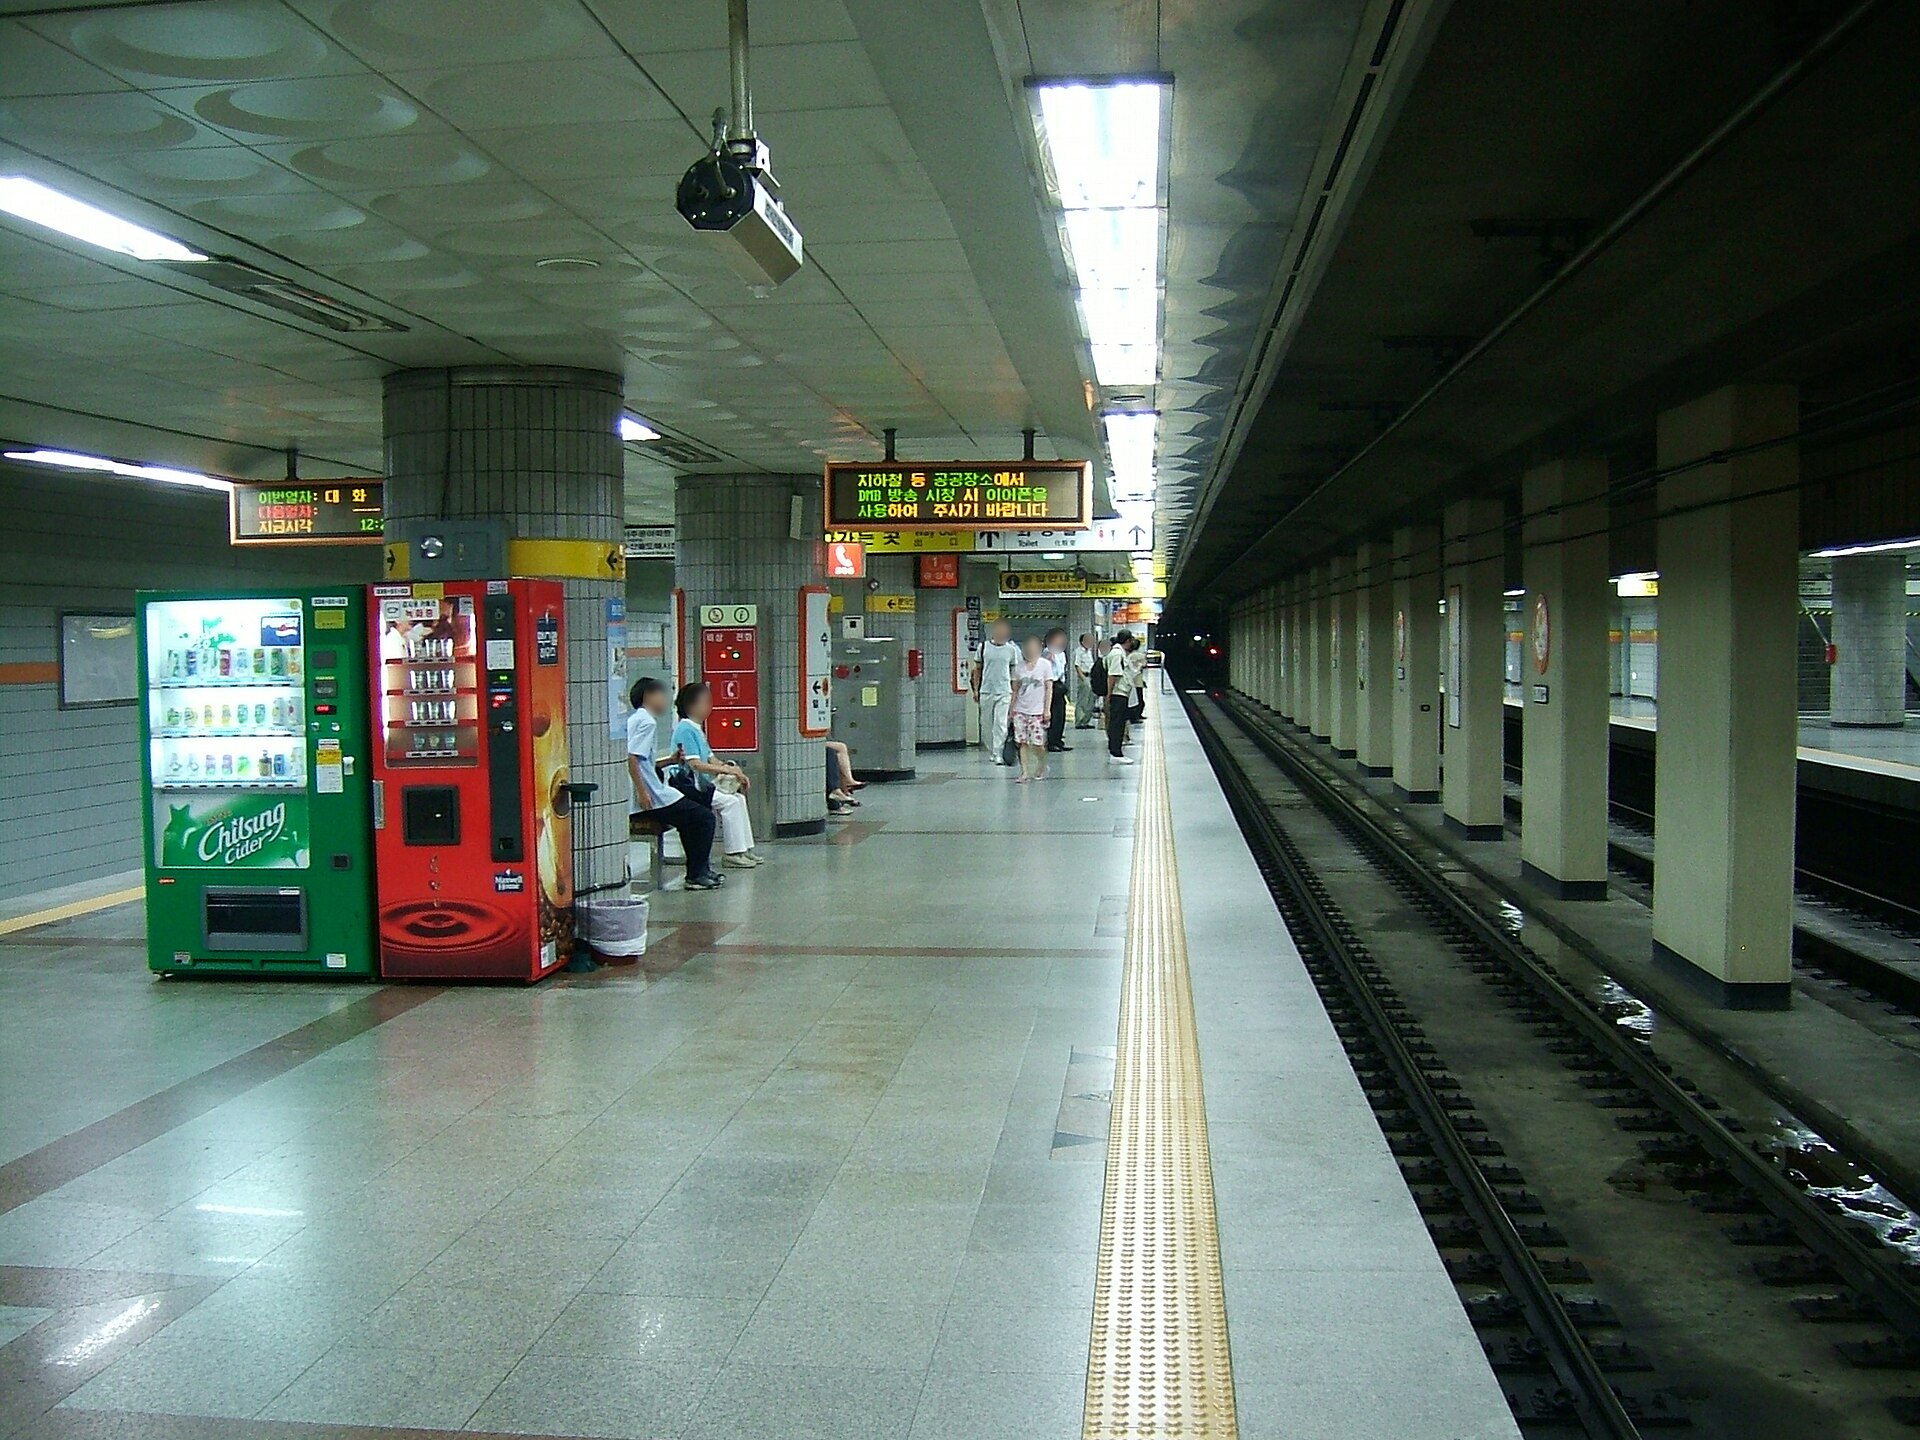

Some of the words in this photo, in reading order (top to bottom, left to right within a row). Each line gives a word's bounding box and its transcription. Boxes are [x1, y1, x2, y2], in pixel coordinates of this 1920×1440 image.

[857, 473, 903, 488] 지하철
[911, 473, 926, 488] 등
[934, 471, 1025, 487] 공공장소에서
[325, 489, 340, 503] 대
[352, 488, 368, 503] 화
[858, 489, 881, 502] DMB
[887, 488, 918, 502] 방송
[963, 488, 979, 502] 시
[986, 487, 1048, 502] 이어폰을
[857, 503, 918, 518] 사용하여
[933, 503, 979, 517] 주시기
[986, 502, 1049, 517] 바랍니다
[258, 519, 313, 533] 지금시각
[1018, 539, 1038, 548] Toilet
[198, 802, 285, 862] Chilsung
[224, 830, 273, 865] Cider
